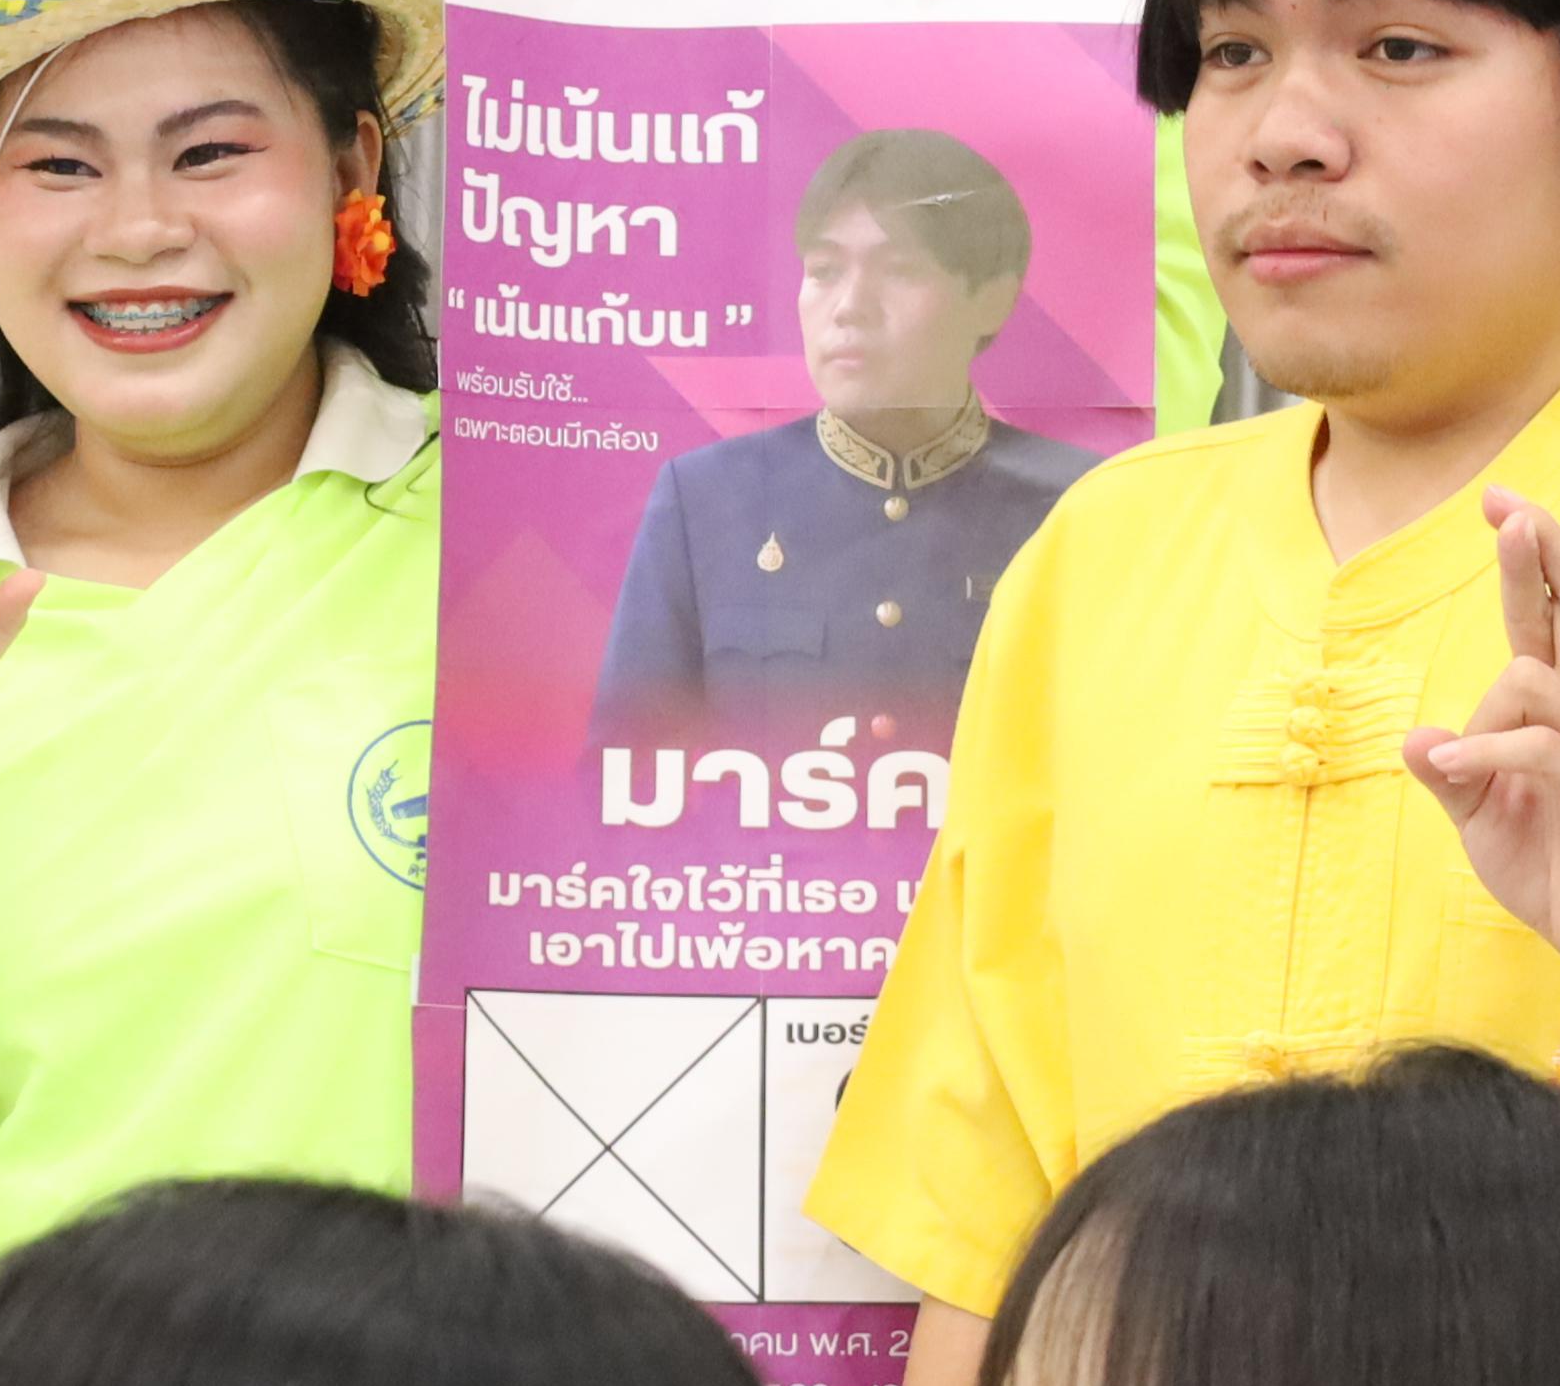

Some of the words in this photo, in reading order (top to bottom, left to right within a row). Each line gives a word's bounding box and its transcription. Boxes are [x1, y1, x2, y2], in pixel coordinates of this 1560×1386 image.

[461, 74, 765, 164] ไม่เน้นแก้
[461, 167, 678, 268] ปัญหา
[456, 366, 588, 403] พร้อมรับใช้...
[454, 417, 659, 451] เฉพาะตอนมีกล้อง
[602, 716, 952, 830] มาร์ค
[488, 854, 878, 914] มาร์คใจไว้ที่เธอ
[786, 1014, 869, 1045] เบอร์
[809, 1332, 878, 1356] พ.ศ.
